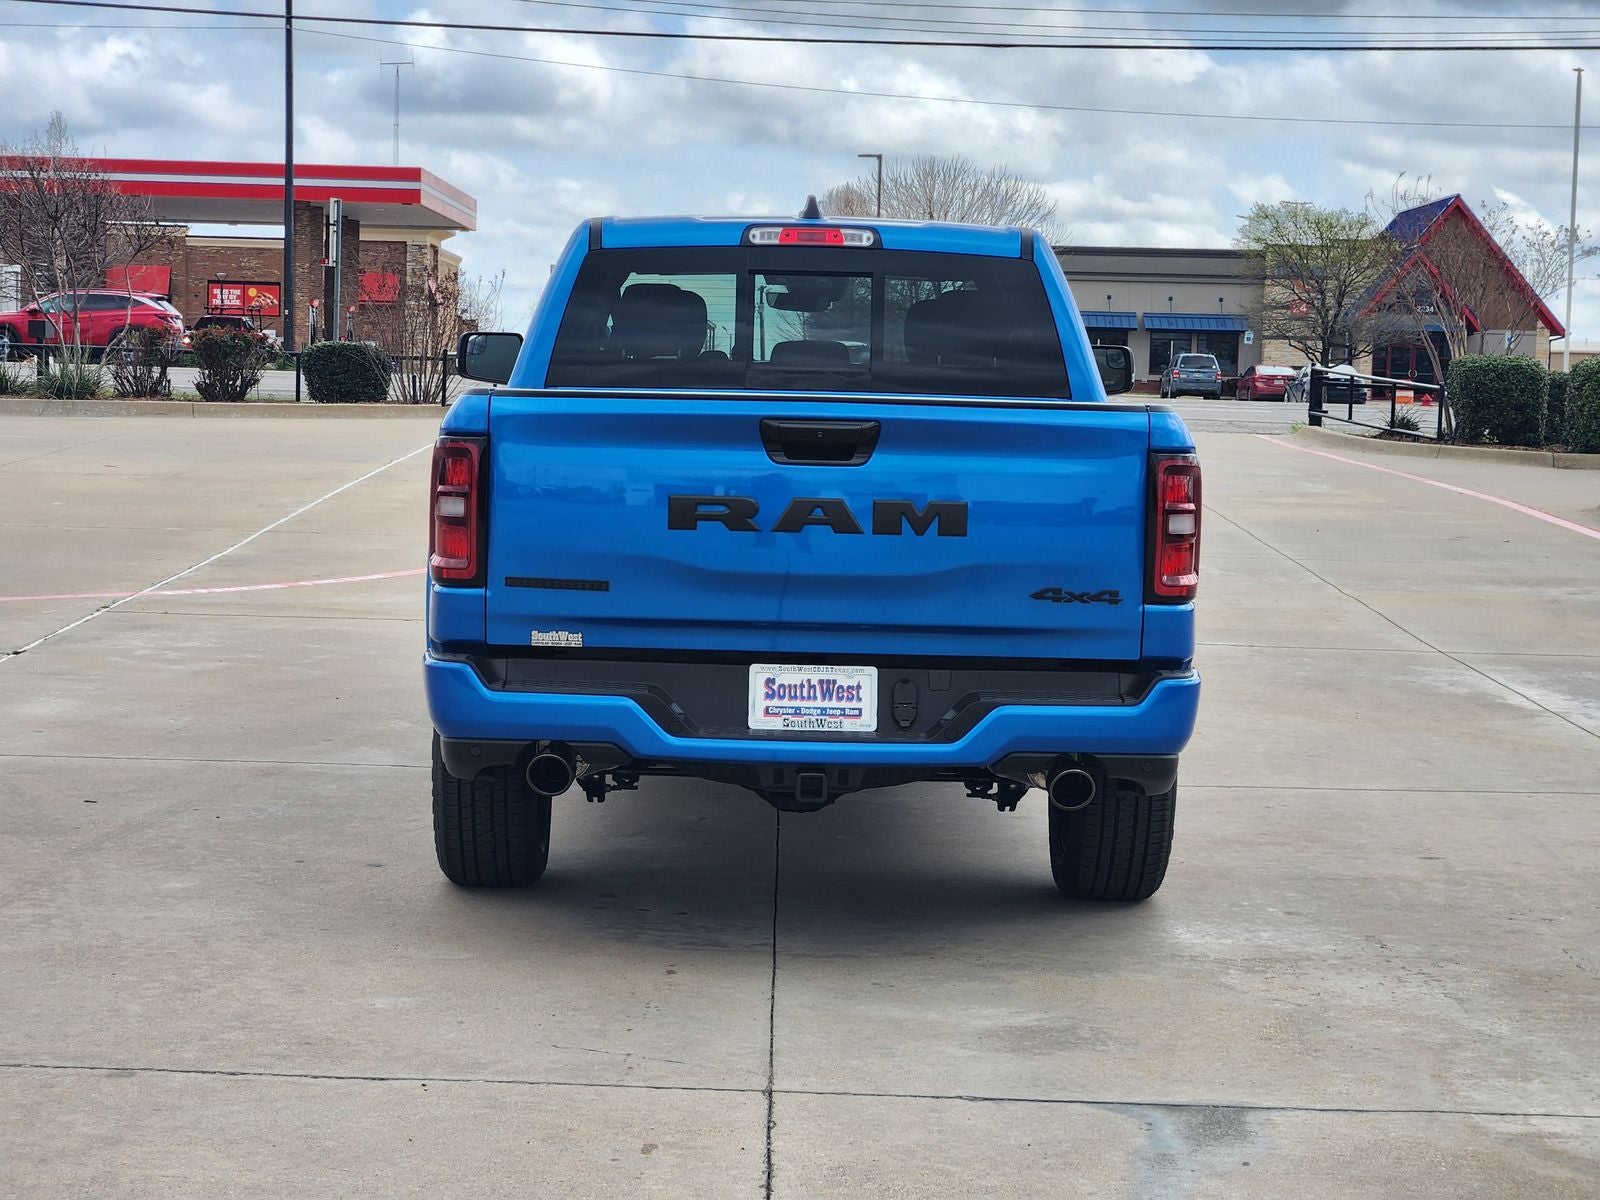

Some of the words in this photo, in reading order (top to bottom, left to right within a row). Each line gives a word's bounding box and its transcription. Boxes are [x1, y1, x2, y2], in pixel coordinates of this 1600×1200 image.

[667, 495, 969, 537] RAM
[531, 630, 583, 641] SouthWest
[764, 677, 863, 703] SouthWest
[768, 707, 796, 715] Chrysler
[801, 708, 821, 716] Dodge
[826, 708, 841, 716] Jeep
[783, 718, 843, 729] SouthWest
